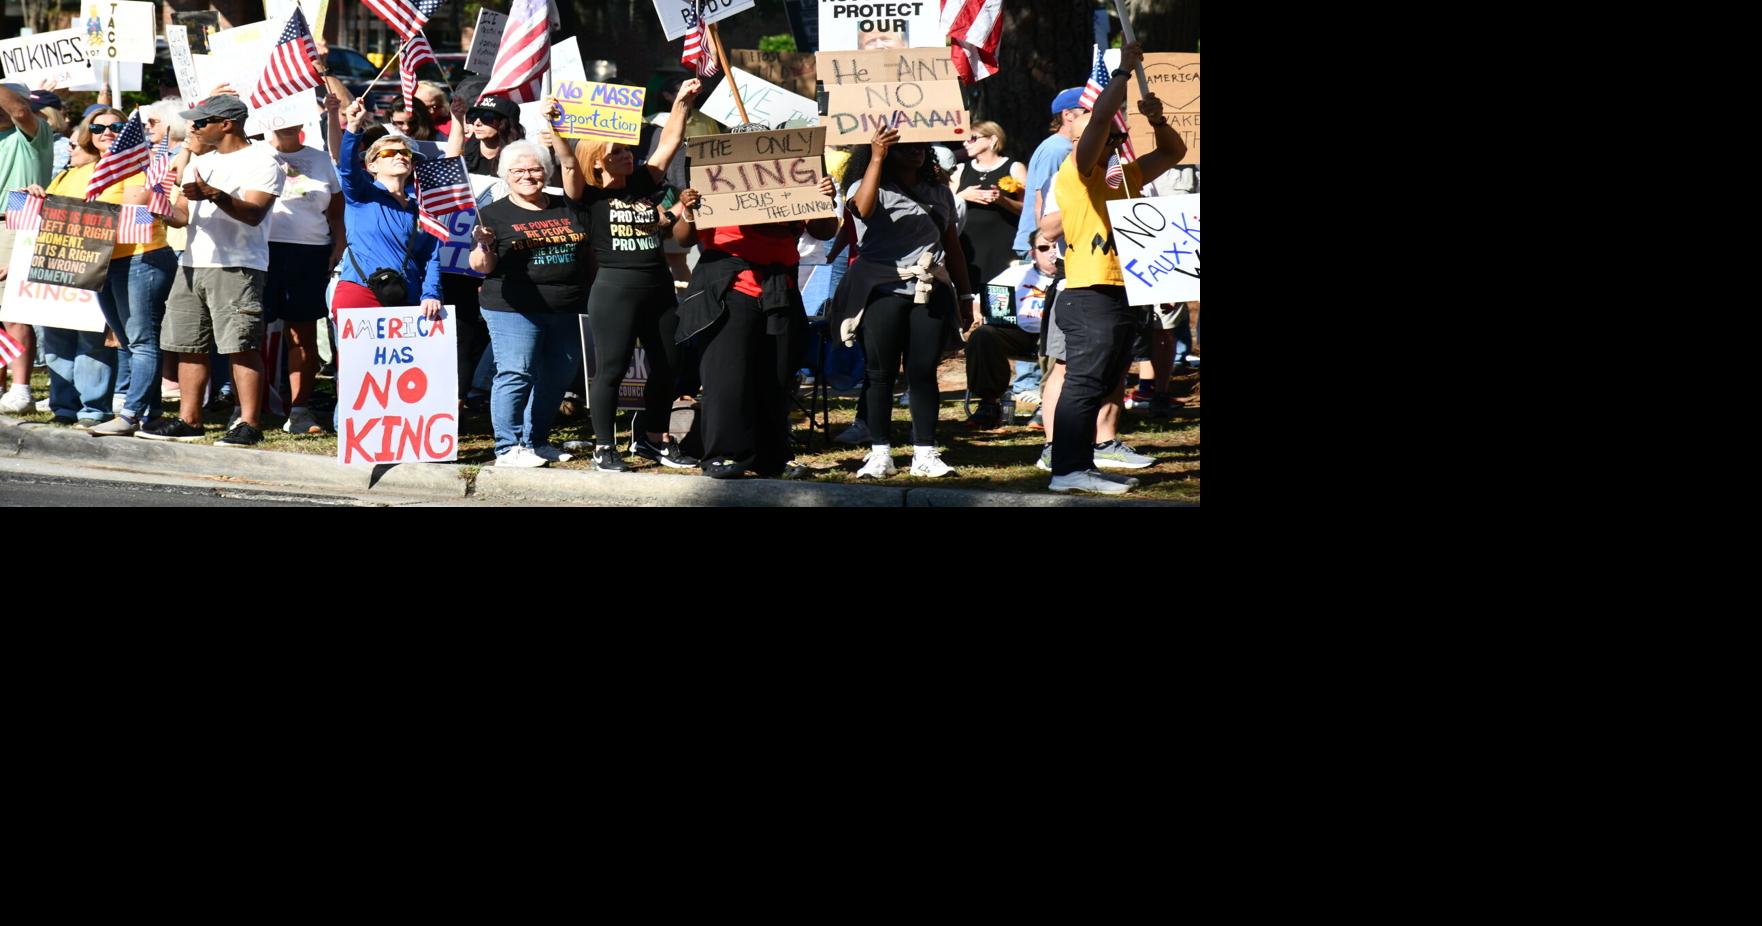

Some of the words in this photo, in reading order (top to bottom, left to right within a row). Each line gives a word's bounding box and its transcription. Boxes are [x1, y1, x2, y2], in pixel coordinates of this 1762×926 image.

[833, 2, 923, 18] PROTECT
[107, 3, 118, 58] TACO
[859, 19, 907, 32] OUR
[1, 47, 26, 73] NO
[832, 58, 871, 86] He
[895, 55, 952, 82] AINT
[1147, 72, 1200, 83] AMERICA
[556, 79, 583, 99] No
[591, 83, 644, 107] MASS
[866, 82, 924, 108] NO
[1165, 114, 1200, 127] AKE
[688, 139, 732, 159] THE
[756, 131, 813, 155] ONLY
[705, 158, 818, 192] KING
[729, 192, 774, 211] JESUS
[43, 207, 66, 220] THIS
[69, 211, 80, 222] IS
[82, 213, 102, 225] NOT
[104, 216, 112, 227] A
[609, 209, 633, 223] PRO
[759, 206, 790, 219] THE
[41, 221, 63, 234] LEFT
[66, 223, 82, 235] OR
[83, 226, 115, 241] RIGHT
[511, 223, 528, 232] THE
[528, 219, 561, 229] POWER
[560, 217, 571, 226] OF
[524, 229, 541, 238] THE
[610, 224, 633, 237] PRO
[1113, 202, 1166, 249] NO
[36, 232, 85, 249] MOMENT.
[612, 238, 636, 251] PRO
[1124, 212, 1200, 287] FAUX-K
[34, 244, 44, 255] IT
[45, 245, 57, 257] IS
[58, 248, 67, 259] A
[69, 249, 102, 263] RIGHT
[533, 256, 545, 265] IN
[32, 256, 44, 268] OR
[47, 257, 86, 274] WRONG
[29, 269, 76, 286] MOMENT.
[18, 280, 93, 303] KINGS
[342, 314, 446, 340] AMERICA
[373, 345, 414, 365] HAS
[352, 367, 428, 411] NO
[344, 413, 455, 464] KING
